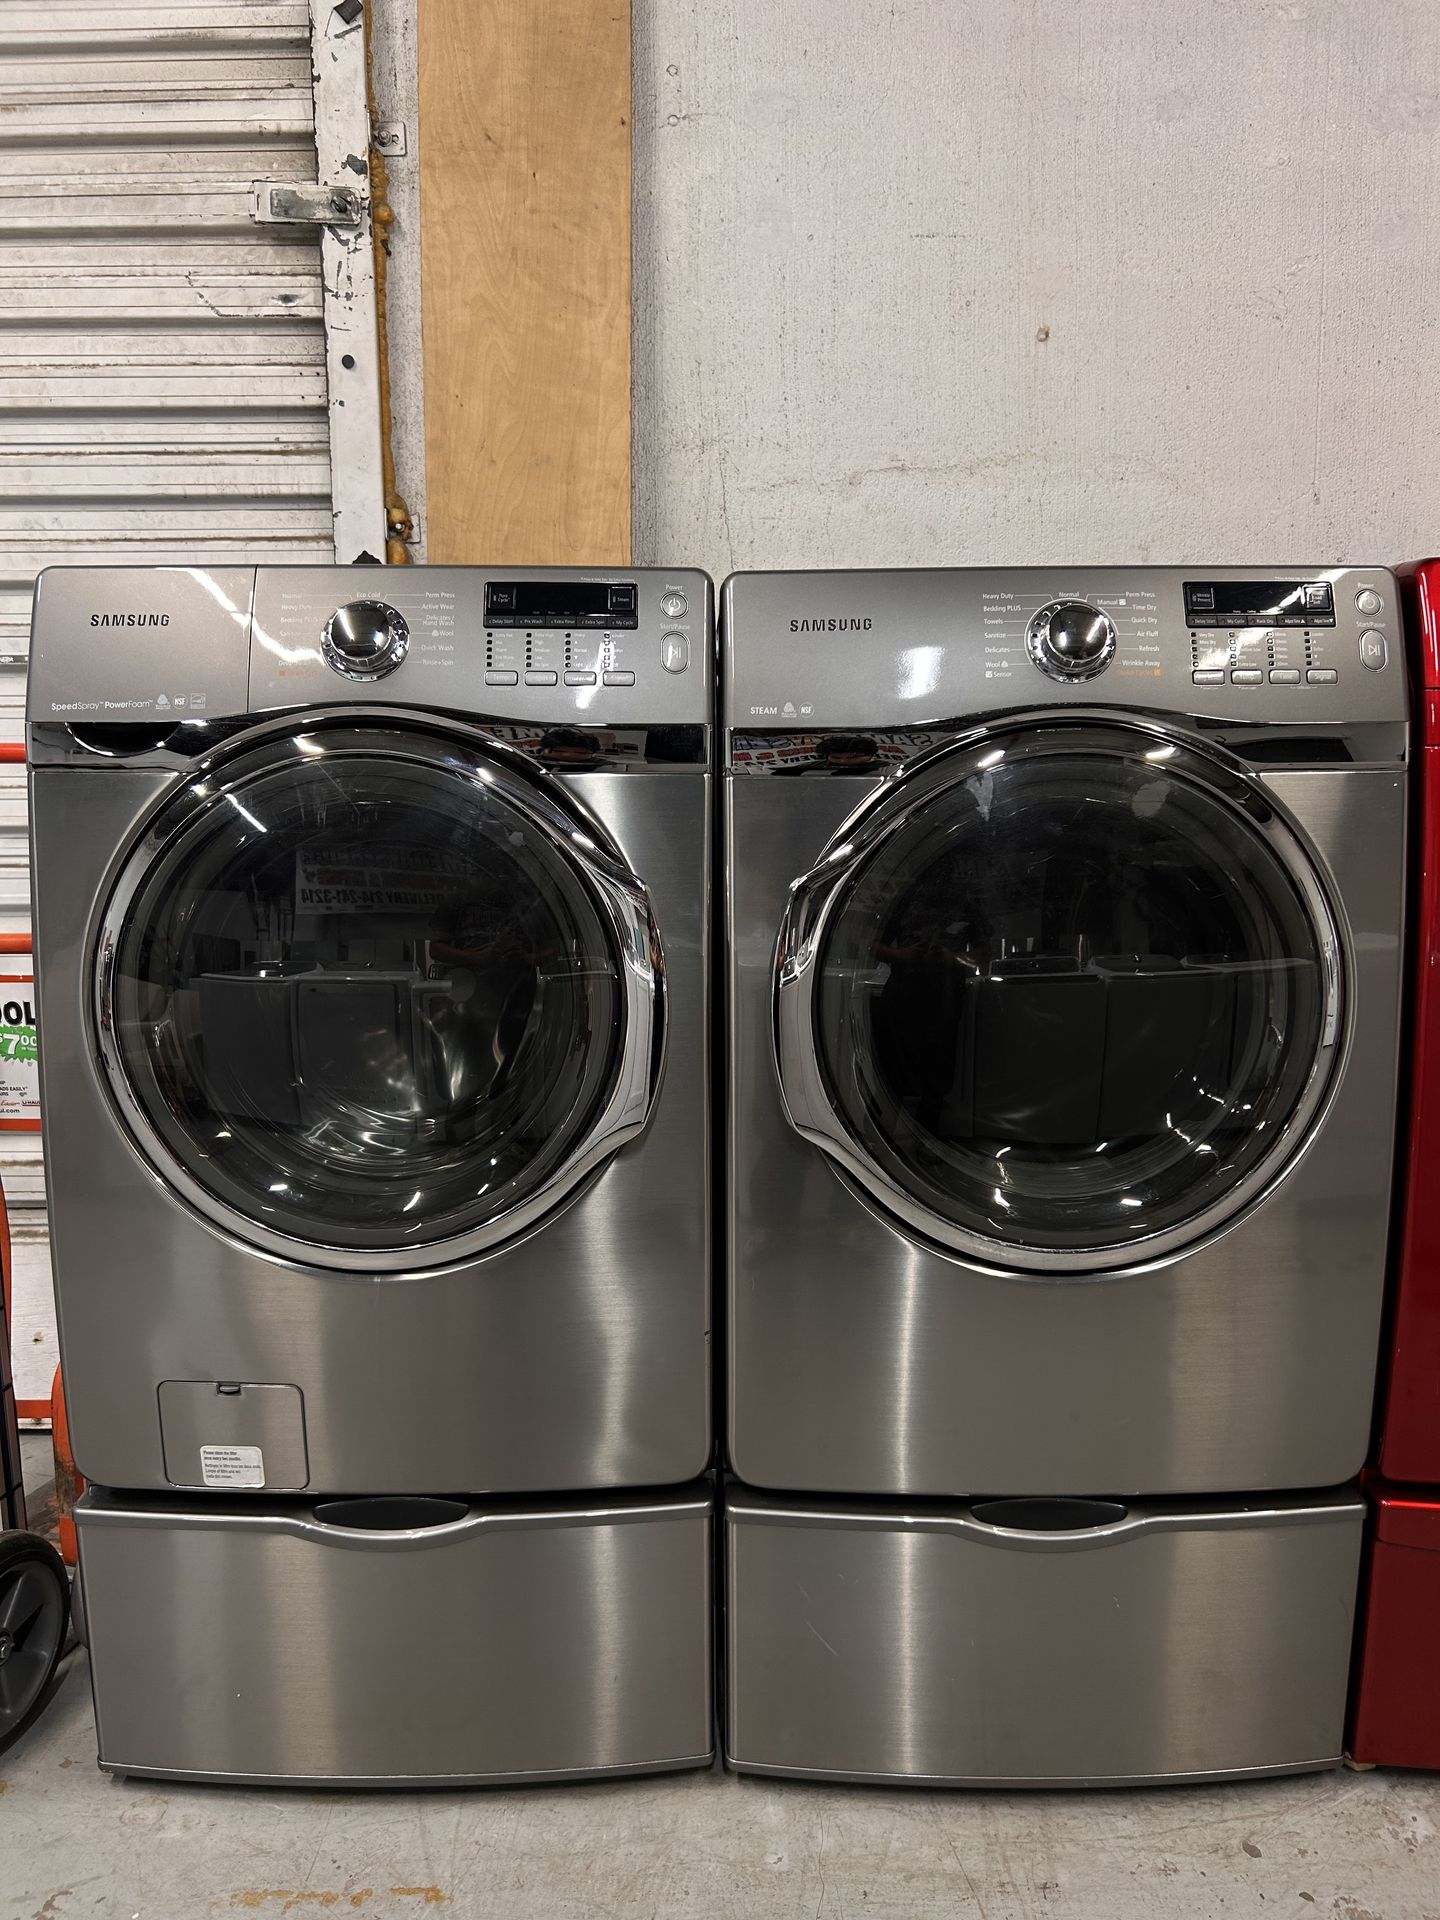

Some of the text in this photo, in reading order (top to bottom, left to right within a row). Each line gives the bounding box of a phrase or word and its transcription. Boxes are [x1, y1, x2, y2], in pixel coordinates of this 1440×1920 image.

[90, 614, 170, 626] SAMSUNG
[790, 618, 872, 632] SAMSUNG
[0, 1001, 35, 1026] OL
